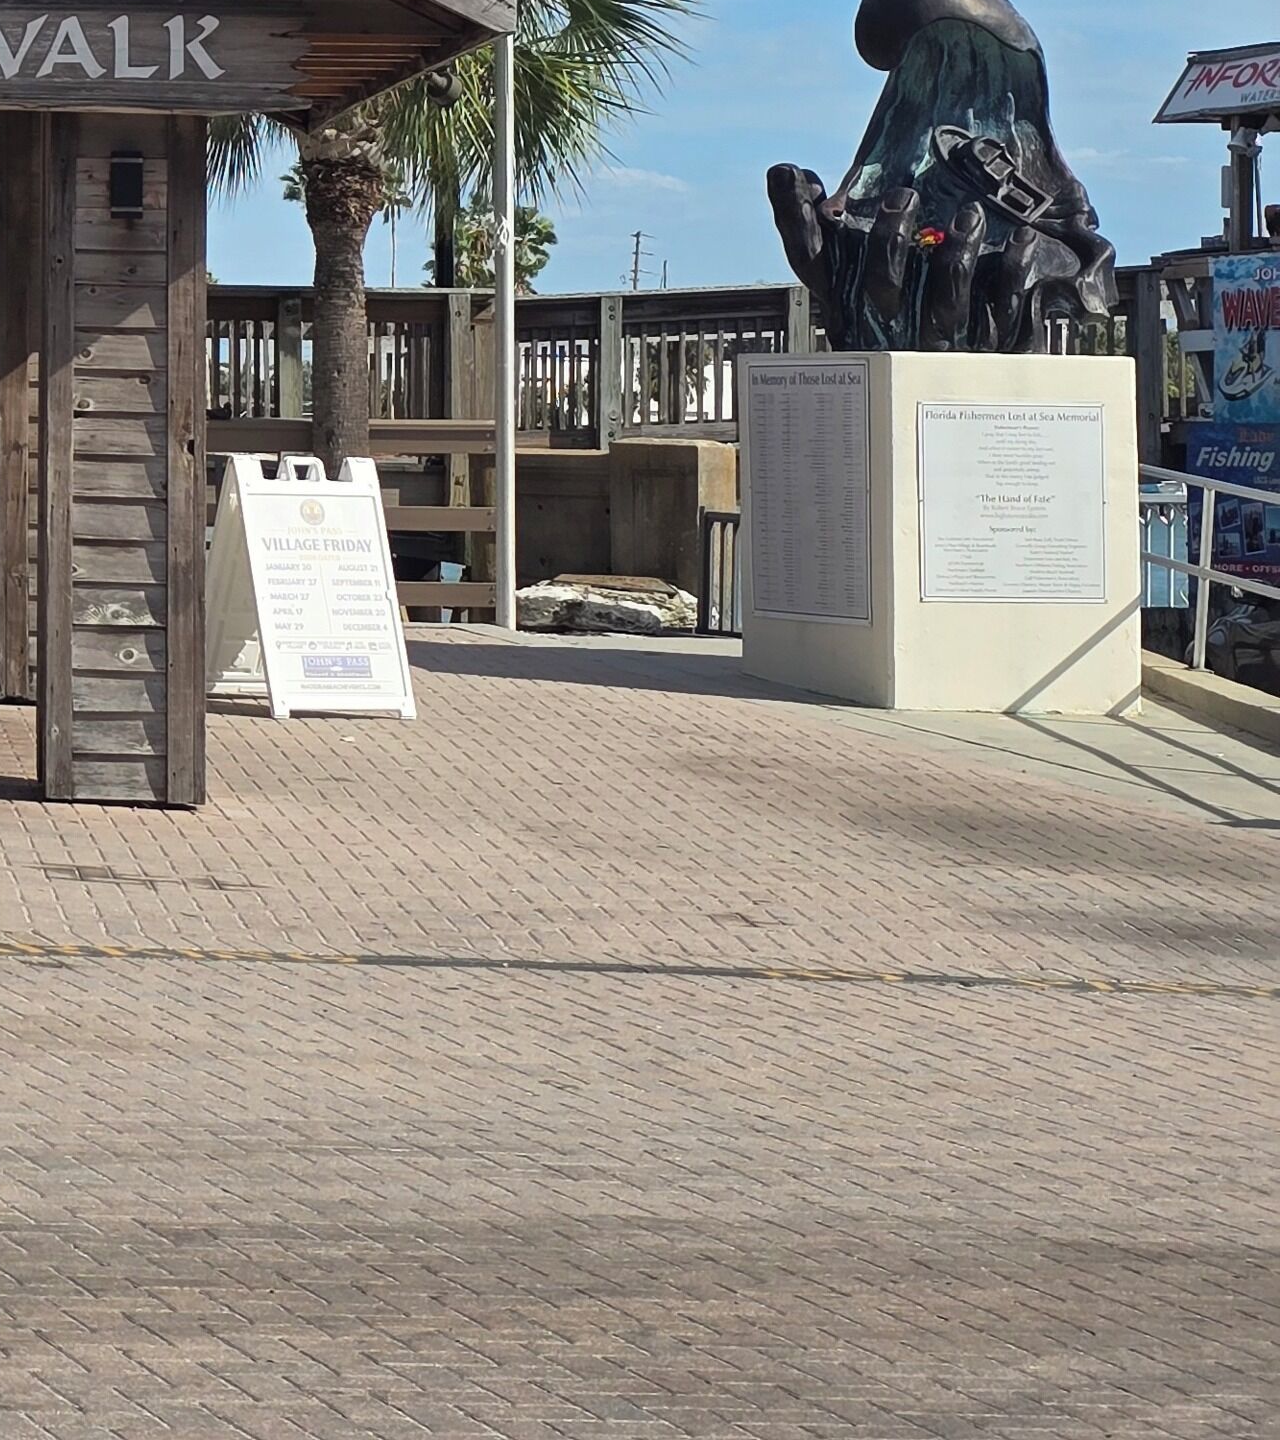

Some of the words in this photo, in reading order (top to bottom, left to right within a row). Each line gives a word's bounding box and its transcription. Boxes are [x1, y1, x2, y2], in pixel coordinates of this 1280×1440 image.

[1184, 58, 1280, 99] INFOR
[752, 373, 758, 385] In
[760, 373, 787, 389] Memory
[789, 371, 797, 385] of
[798, 372, 819, 385] Those
[821, 372, 836, 385] Lost
[838, 372, 846, 385] at
[848, 371, 861, 385] Sea
[925, 411, 956, 420] Florida
[959, 412, 1005, 421] Fishermen
[1008, 412, 1026, 421] Lost
[1029, 412, 1037, 421] at
[1039, 412, 1054, 421] Sea
[1057, 412, 1099, 422] Memorial
[1196, 446, 1275, 472] Fishing
[998, 494, 1021, 503] Hand
[1023, 494, 1032, 503] of
[261, 537, 321, 551] VILLAGE
[323, 539, 372, 553] FRIDAY
[338, 564, 367, 572] AUGUST
[332, 608, 373, 616] NOVEMBER
